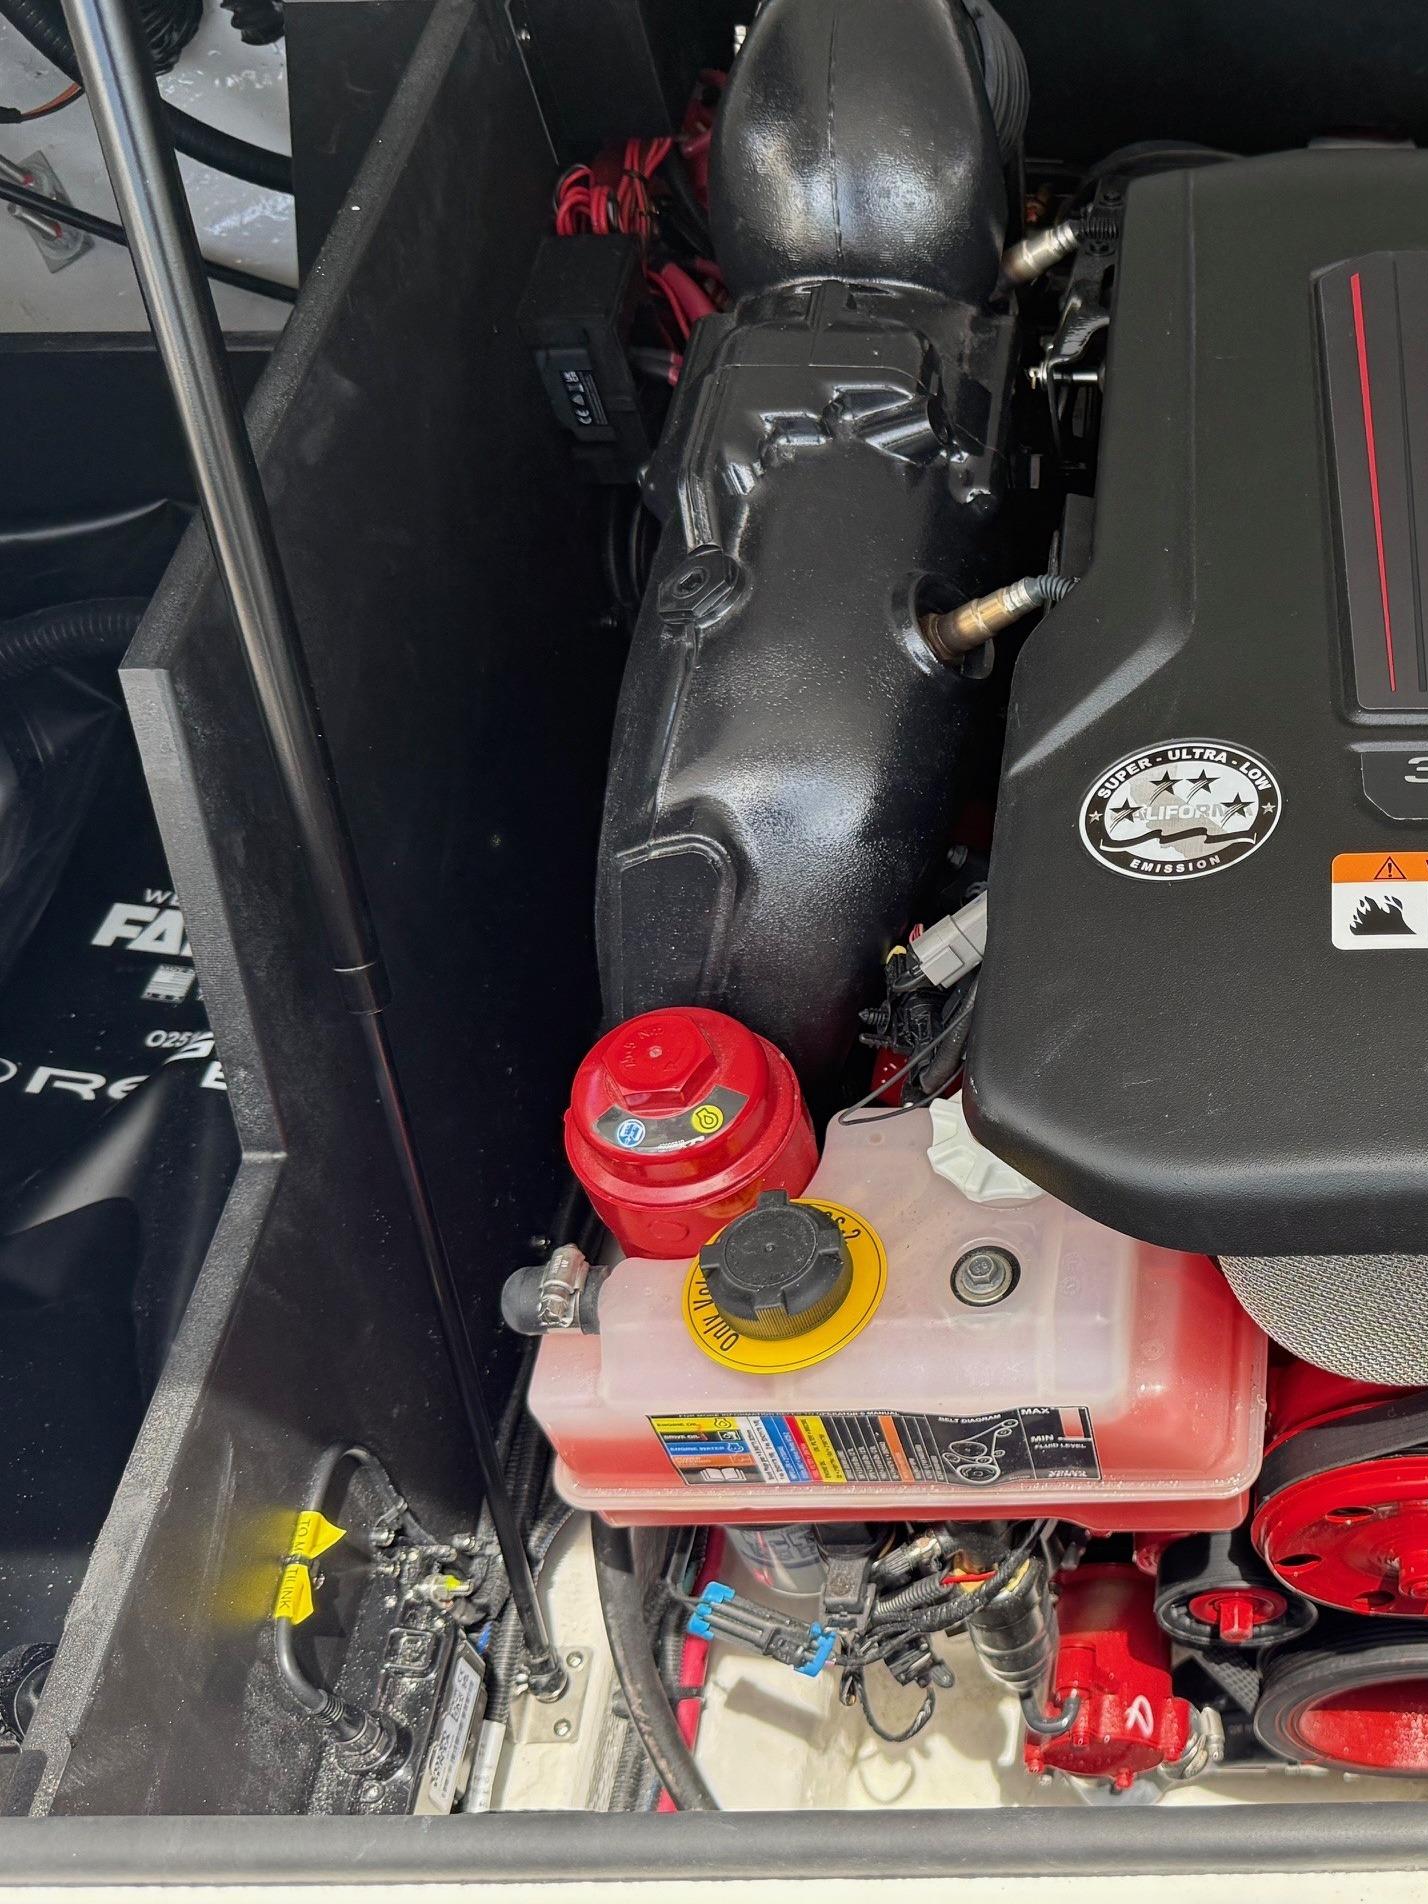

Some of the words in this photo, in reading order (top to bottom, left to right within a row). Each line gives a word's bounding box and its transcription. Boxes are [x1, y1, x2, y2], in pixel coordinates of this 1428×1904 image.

[1097, 757, 1153, 799] SUPER
[1167, 748, 1228, 764] ULTRA
[1239, 761, 1272, 791] LOW
[1129, 855, 1221, 874] EMISSION
[91, 902, 193, 957] FA
[960, 1414, 1001, 1424] DIAGRAM
[1021, 1408, 1050, 1416] MAX
[1031, 1435, 1054, 1443] MIN
[297, 1519, 311, 1538] TO
